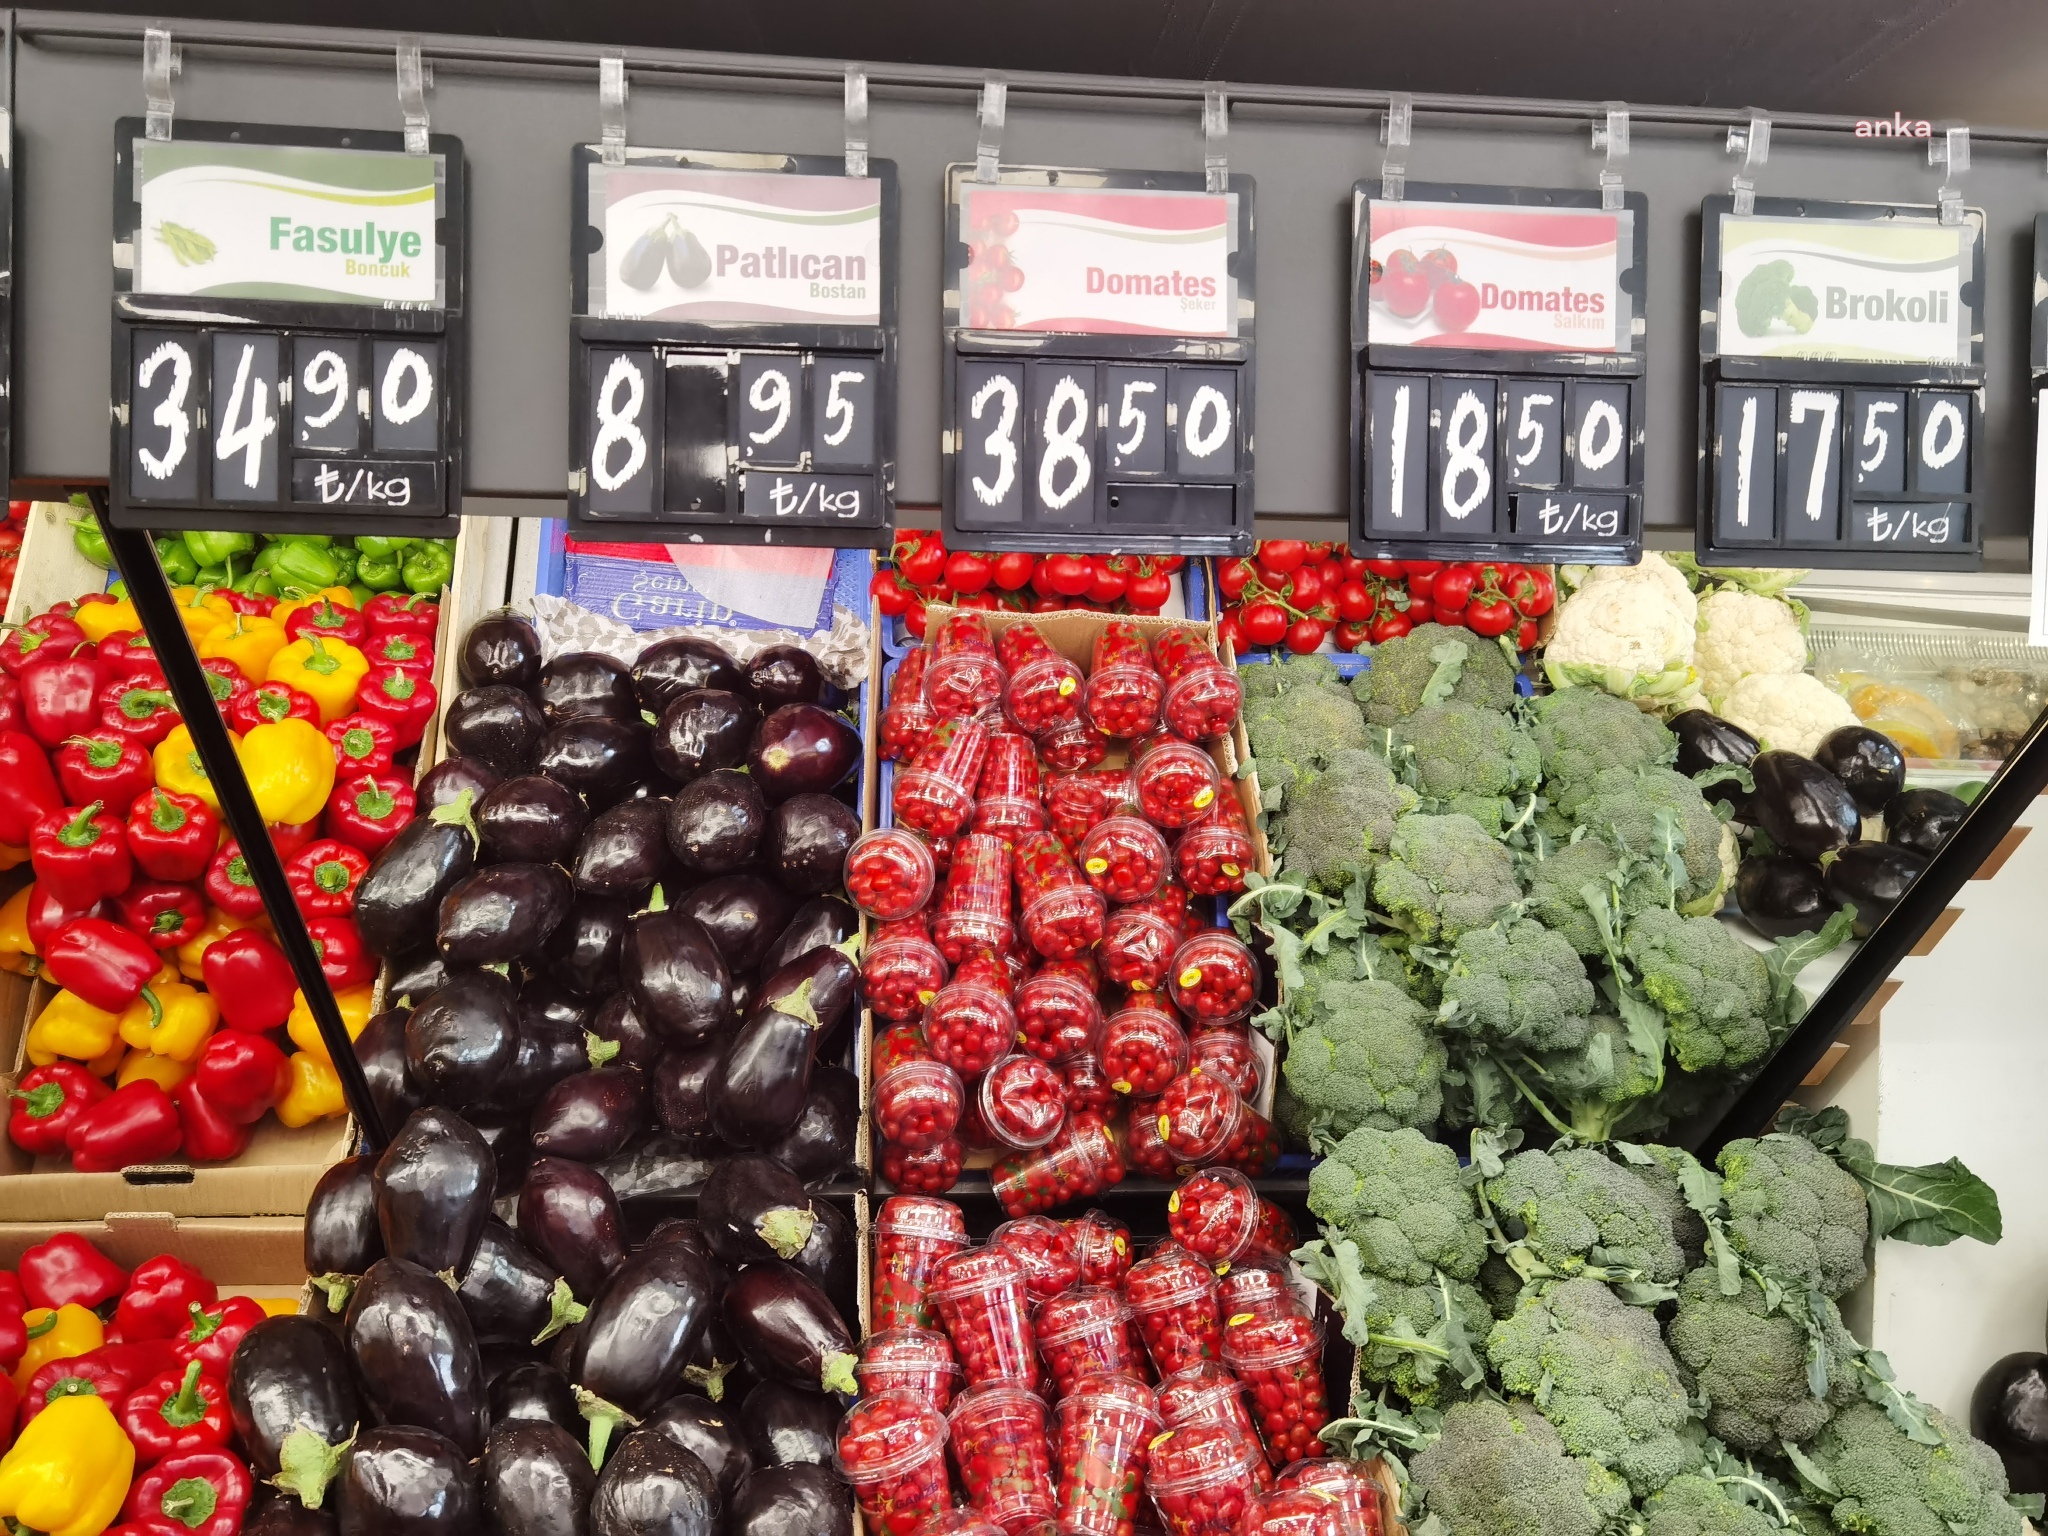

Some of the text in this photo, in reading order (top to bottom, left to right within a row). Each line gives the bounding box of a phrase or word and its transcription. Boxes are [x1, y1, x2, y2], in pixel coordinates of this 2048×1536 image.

[269, 216, 422, 263] Fasulye
[344, 258, 412, 279] Boncuk
[716, 243, 866, 281] Patlıcan
[809, 282, 866, 299] Bostan
[1086, 266, 1217, 297] Domates
[1480, 282, 1605, 314] Domates
[1825, 285, 1949, 324] Brokoli
[1553, 312, 1605, 330] Salkım
